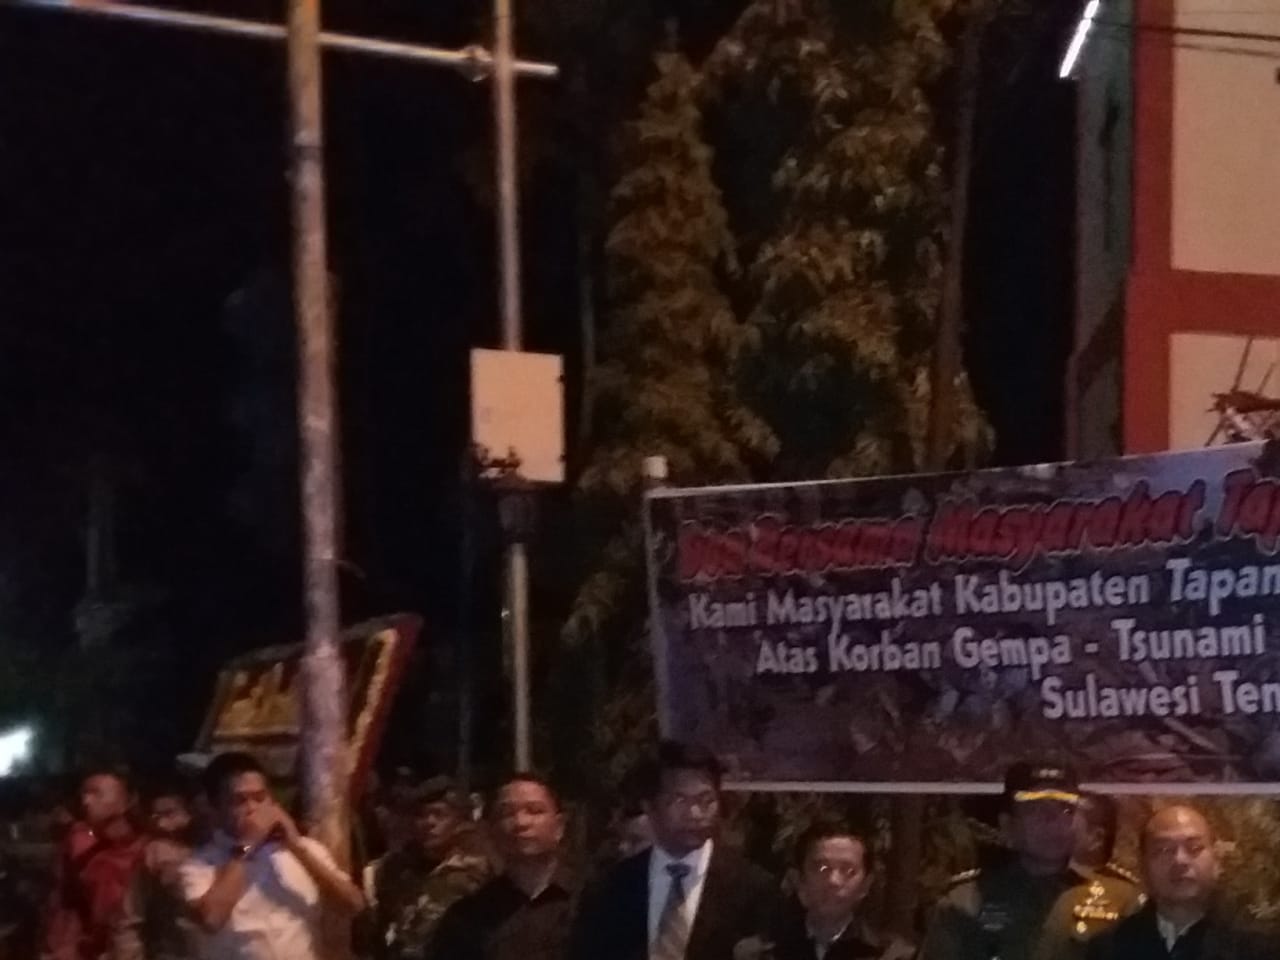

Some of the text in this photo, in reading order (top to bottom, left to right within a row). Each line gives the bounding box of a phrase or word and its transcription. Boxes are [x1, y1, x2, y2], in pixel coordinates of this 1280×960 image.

[925, 480, 1205, 575] Masyarakat
[689, 591, 757, 630] Kami
[766, 576, 942, 640] Masyarakat
[954, 572, 1151, 626] Kabupaten
[755, 637, 819, 674] Atas
[827, 628, 942, 672] Korban
[952, 626, 1072, 681] Gempa
[1111, 612, 1266, 662] Tsunami
[1041, 672, 1199, 719] Sulawesi
